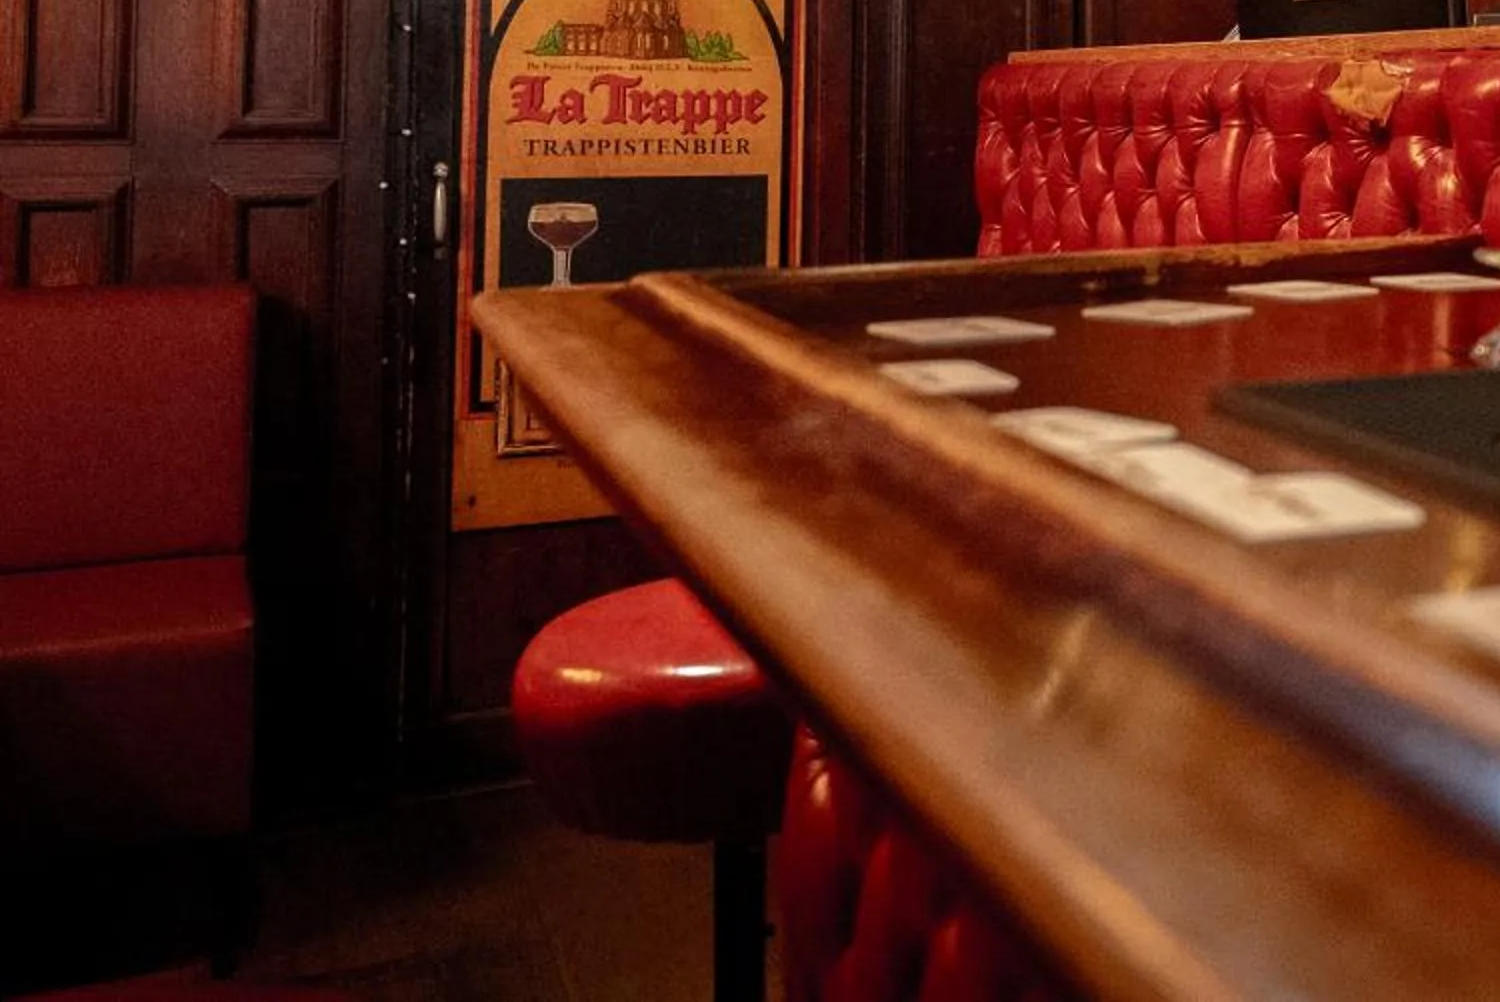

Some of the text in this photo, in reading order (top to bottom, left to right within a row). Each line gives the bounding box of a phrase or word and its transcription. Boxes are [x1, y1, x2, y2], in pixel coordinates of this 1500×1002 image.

[504, 73, 769, 135] La Trappe
[523, 137, 751, 157] TRAPPISTENBIER
